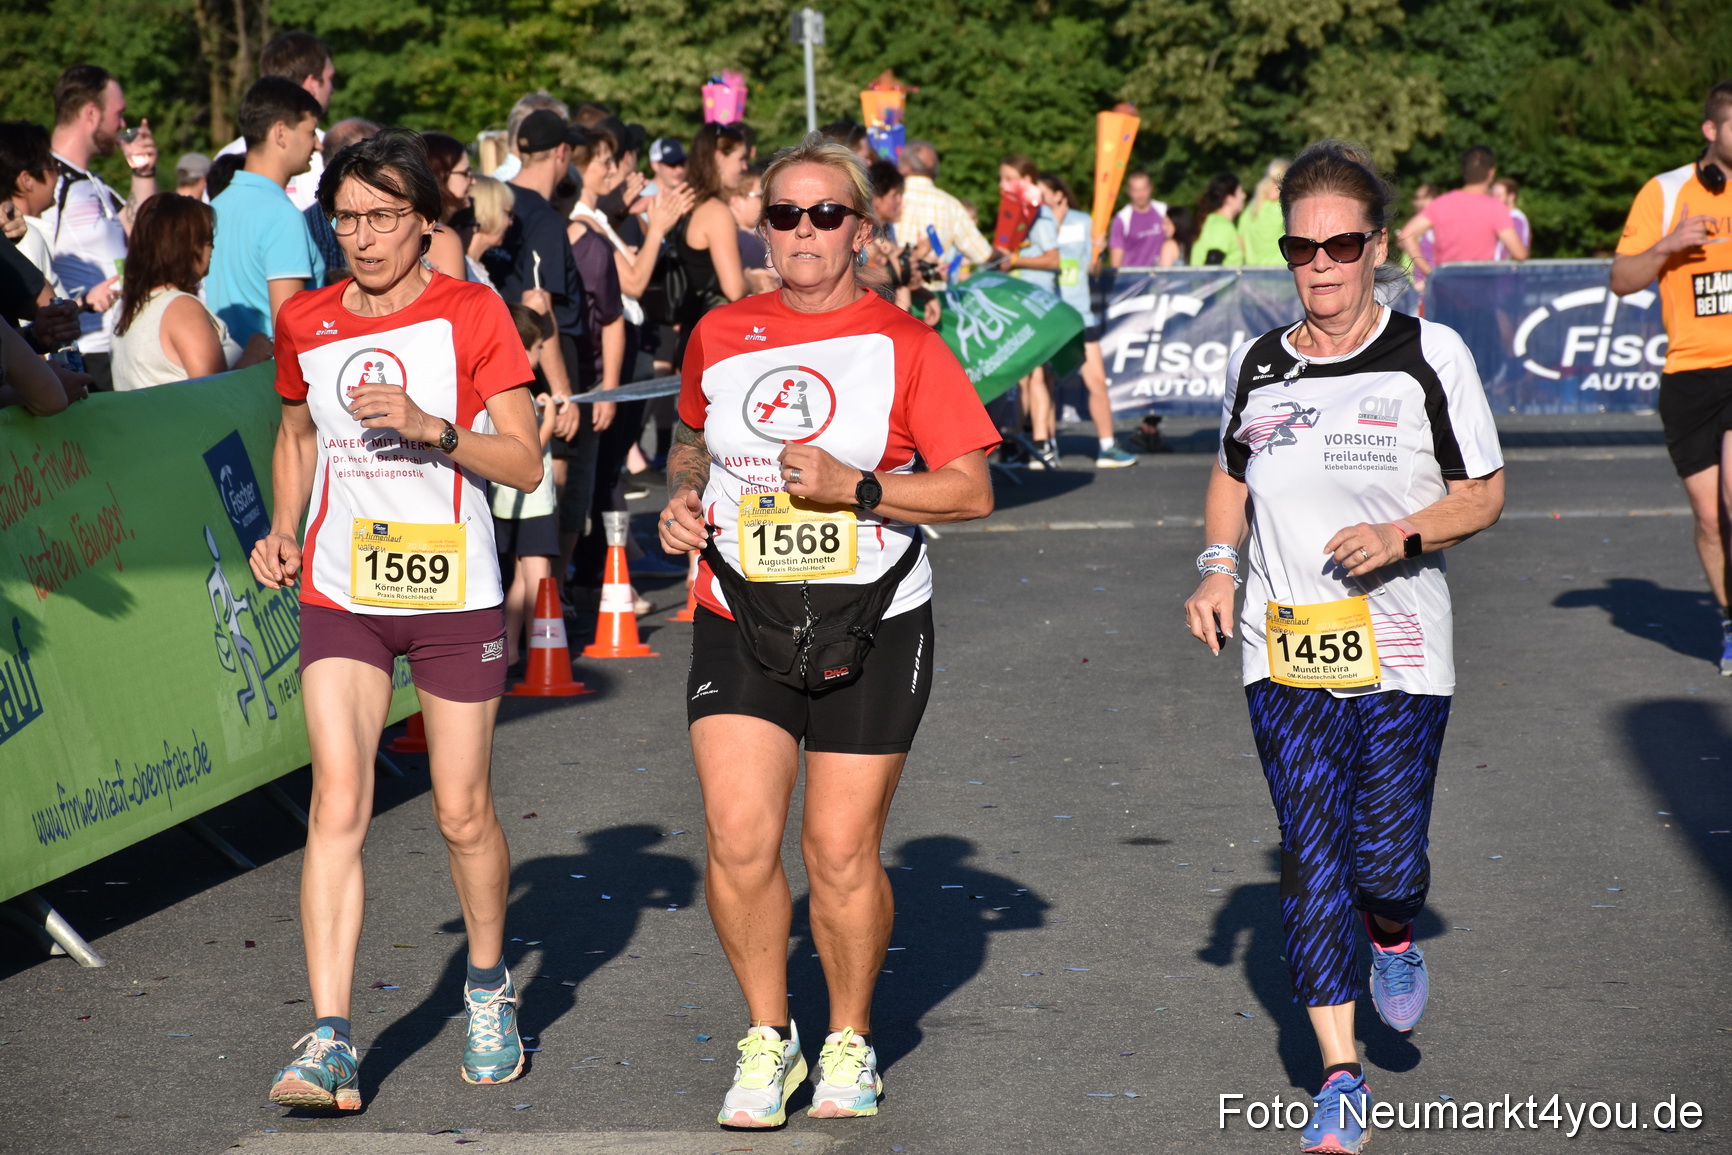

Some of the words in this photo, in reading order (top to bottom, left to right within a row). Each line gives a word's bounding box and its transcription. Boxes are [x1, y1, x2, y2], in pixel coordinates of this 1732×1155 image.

[1696, 296, 1717, 316] BEI
[1580, 371, 1661, 391] AUTO
[1358, 395, 1403, 419] OM
[371, 438, 394, 448] MIT
[399, 437, 432, 452] HER
[1324, 433, 1398, 447] VORSICHT!
[333, 455, 347, 464] Dr.
[348, 455, 369, 464] Heck
[377, 454, 391, 463] Dr.
[393, 453, 423, 465] Röschl
[1323, 451, 1398, 463] Freilaufende
[1324, 463, 1399, 471] Klebebandspezialisten
[747, 474, 778, 483] Heck
[752, 506, 790, 516] firmenlauf
[365, 532, 403, 543] firmenlauf
[752, 522, 840, 556] 1568
[364, 550, 450, 585] 1569
[757, 557, 798, 568] Augustin
[800, 555, 836, 565] Annette
[787, 564, 826, 572] Röschl-Heck
[374, 582, 404, 593] Körner
[406, 585, 438, 594] Renate
[376, 591, 395, 599] Praxis
[396, 593, 434, 601] Röschl-Heck
[1276, 630, 1363, 664] 1458
[1292, 664, 1320, 674] Mundt
[1322, 665, 1349, 673] Elvira
[1286, 672, 1336, 680] OM-Klebetechnik
[1337, 672, 1358, 680] GmbH
